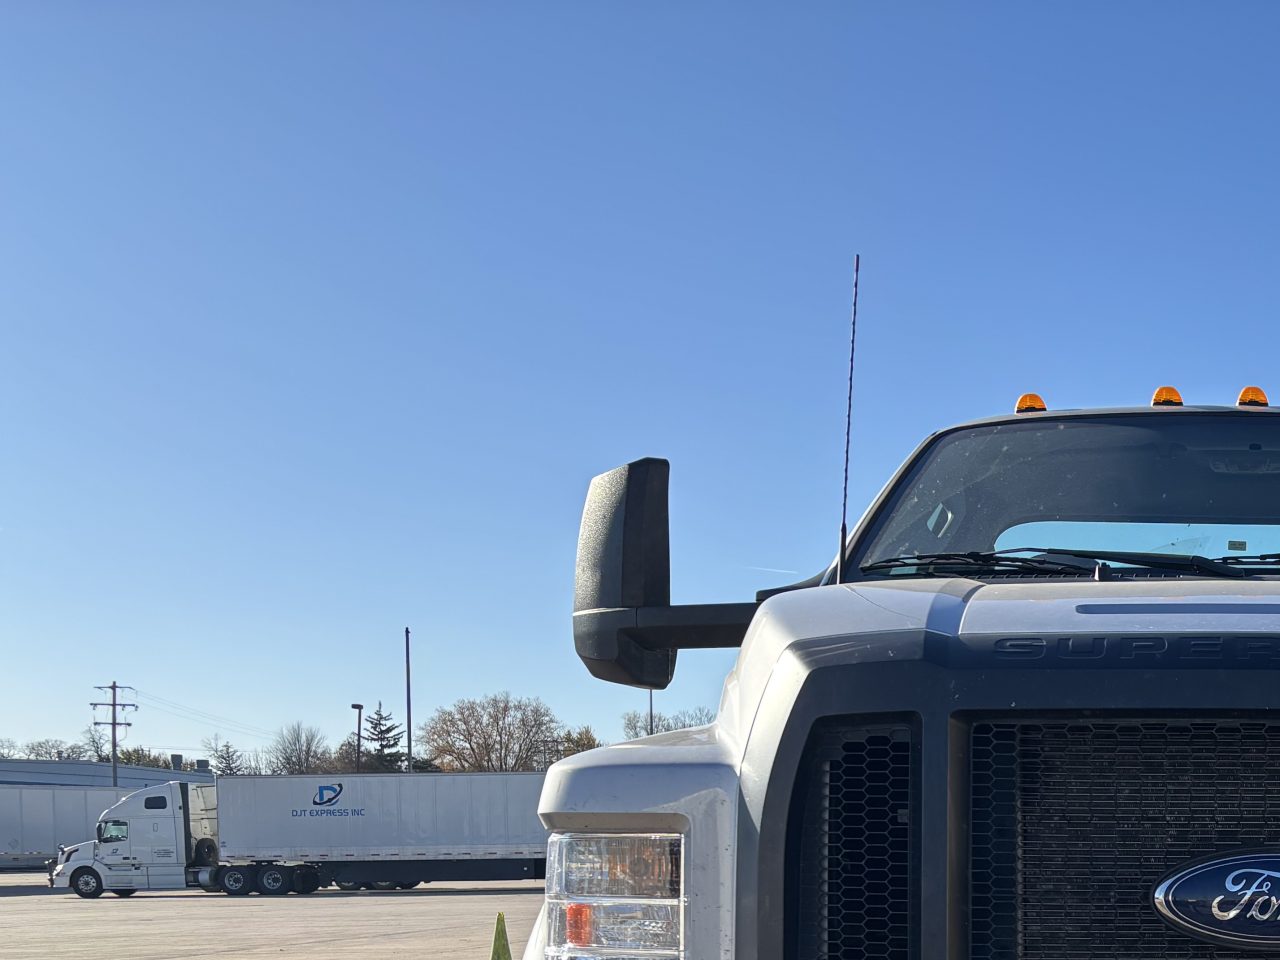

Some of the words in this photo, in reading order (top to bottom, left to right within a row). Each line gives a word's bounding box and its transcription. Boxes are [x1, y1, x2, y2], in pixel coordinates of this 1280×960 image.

[291, 809, 308, 817] DJT
[309, 808, 350, 817] EXPRESS
[351, 808, 366, 816] INC
